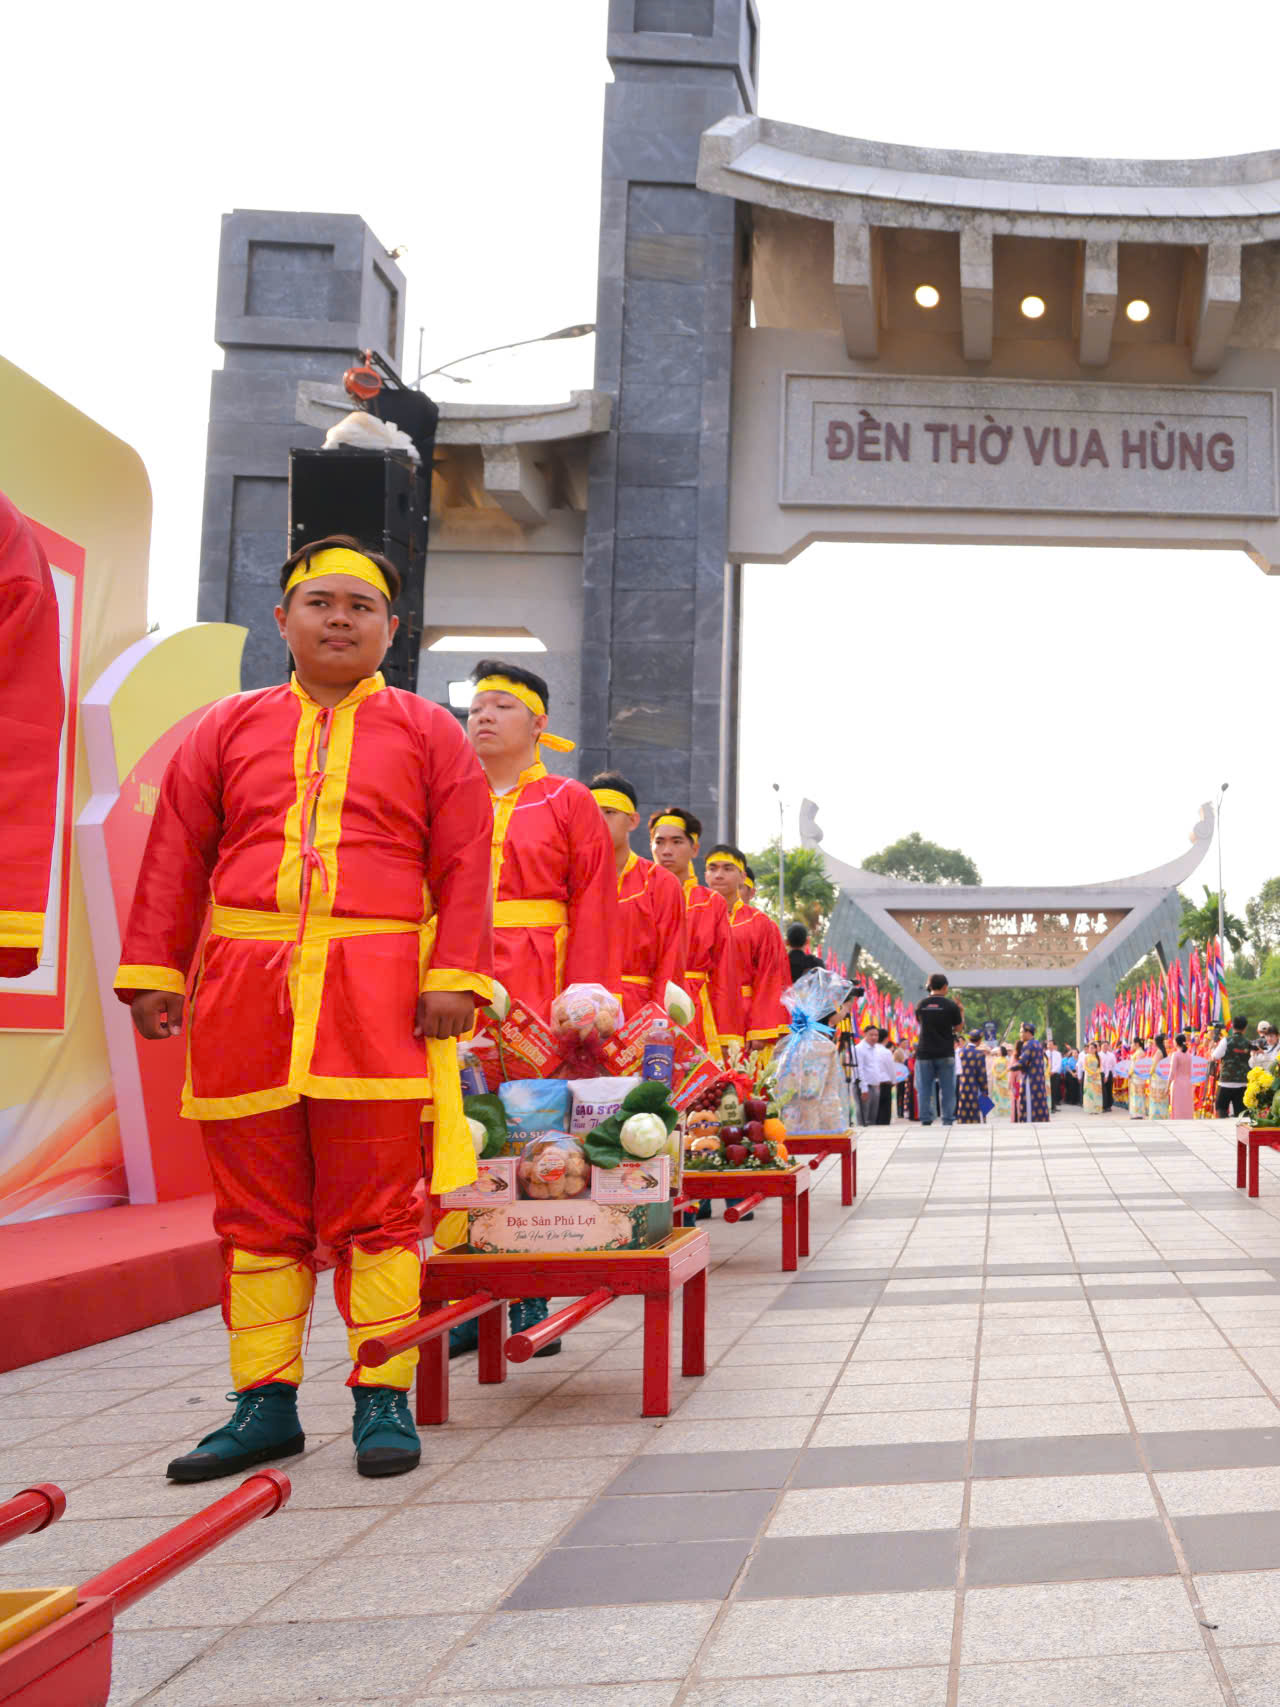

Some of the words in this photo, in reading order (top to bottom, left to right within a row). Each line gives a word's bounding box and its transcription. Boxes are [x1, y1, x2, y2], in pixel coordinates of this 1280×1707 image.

[825, 409, 910, 462] ĐỀN
[924, 414, 1013, 466] THỜ
[1023, 425, 1110, 468] VUA
[1121, 420, 1235, 473] HÙNG
